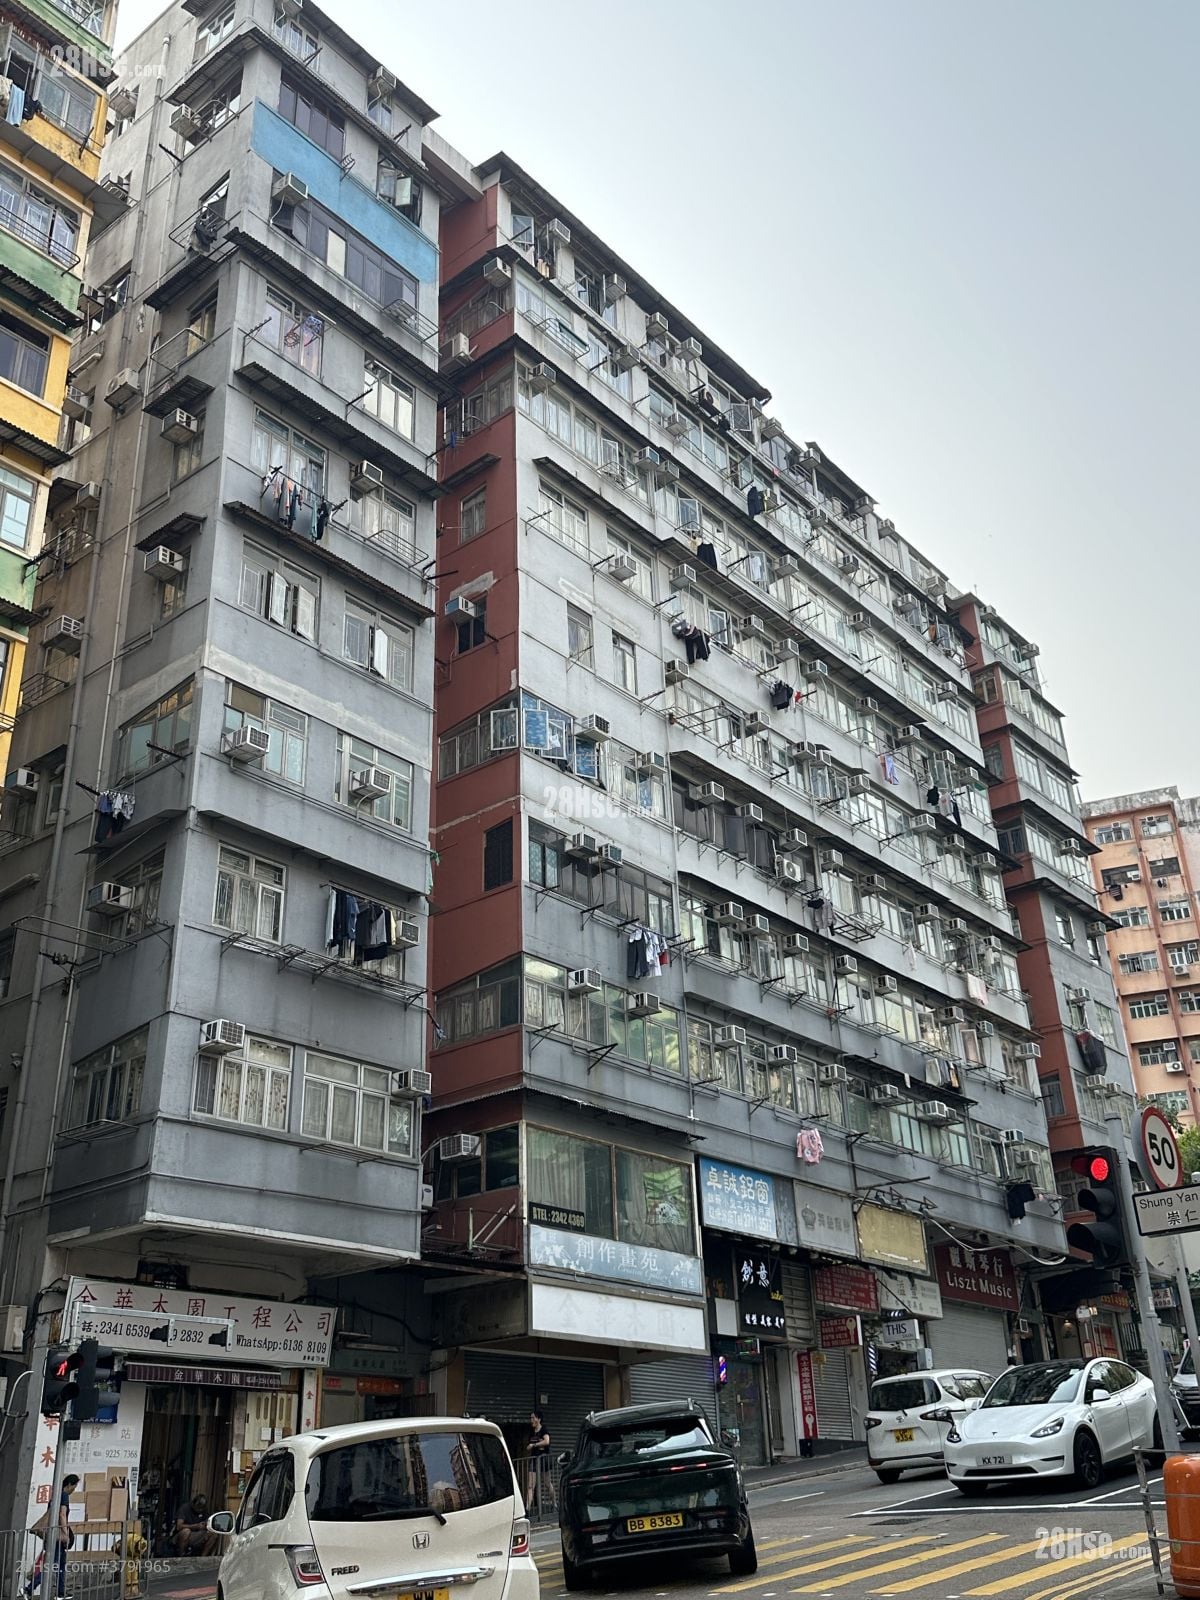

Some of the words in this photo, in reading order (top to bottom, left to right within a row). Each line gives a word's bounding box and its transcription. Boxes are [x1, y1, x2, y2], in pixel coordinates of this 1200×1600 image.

[1148, 1132, 1175, 1169] 50
[1139, 1196, 1173, 1209] Shung
[1176, 1192, 1199, 1203] Yan
[1167, 1209, 1200, 1226] 崇仁
[946, 1271, 977, 1291] Liszt
[979, 1278, 1013, 1299] Music
[125, 1323, 150, 1338] 6539
[180, 1329, 204, 1343] 2832
[886, 1322, 907, 1336] THIS
[236, 1334, 303, 1352] WhatsApp:6136
[307, 1341, 327, 1354] 8109
[105, 1449, 121, 1459] 9225
[981, 1456, 992, 1464] KX
[993, 1456, 1005, 1464] 721
[629, 1519, 645, 1531] BB
[650, 1515, 681, 1528] 8383
[331, 1565, 360, 1576] FREED
